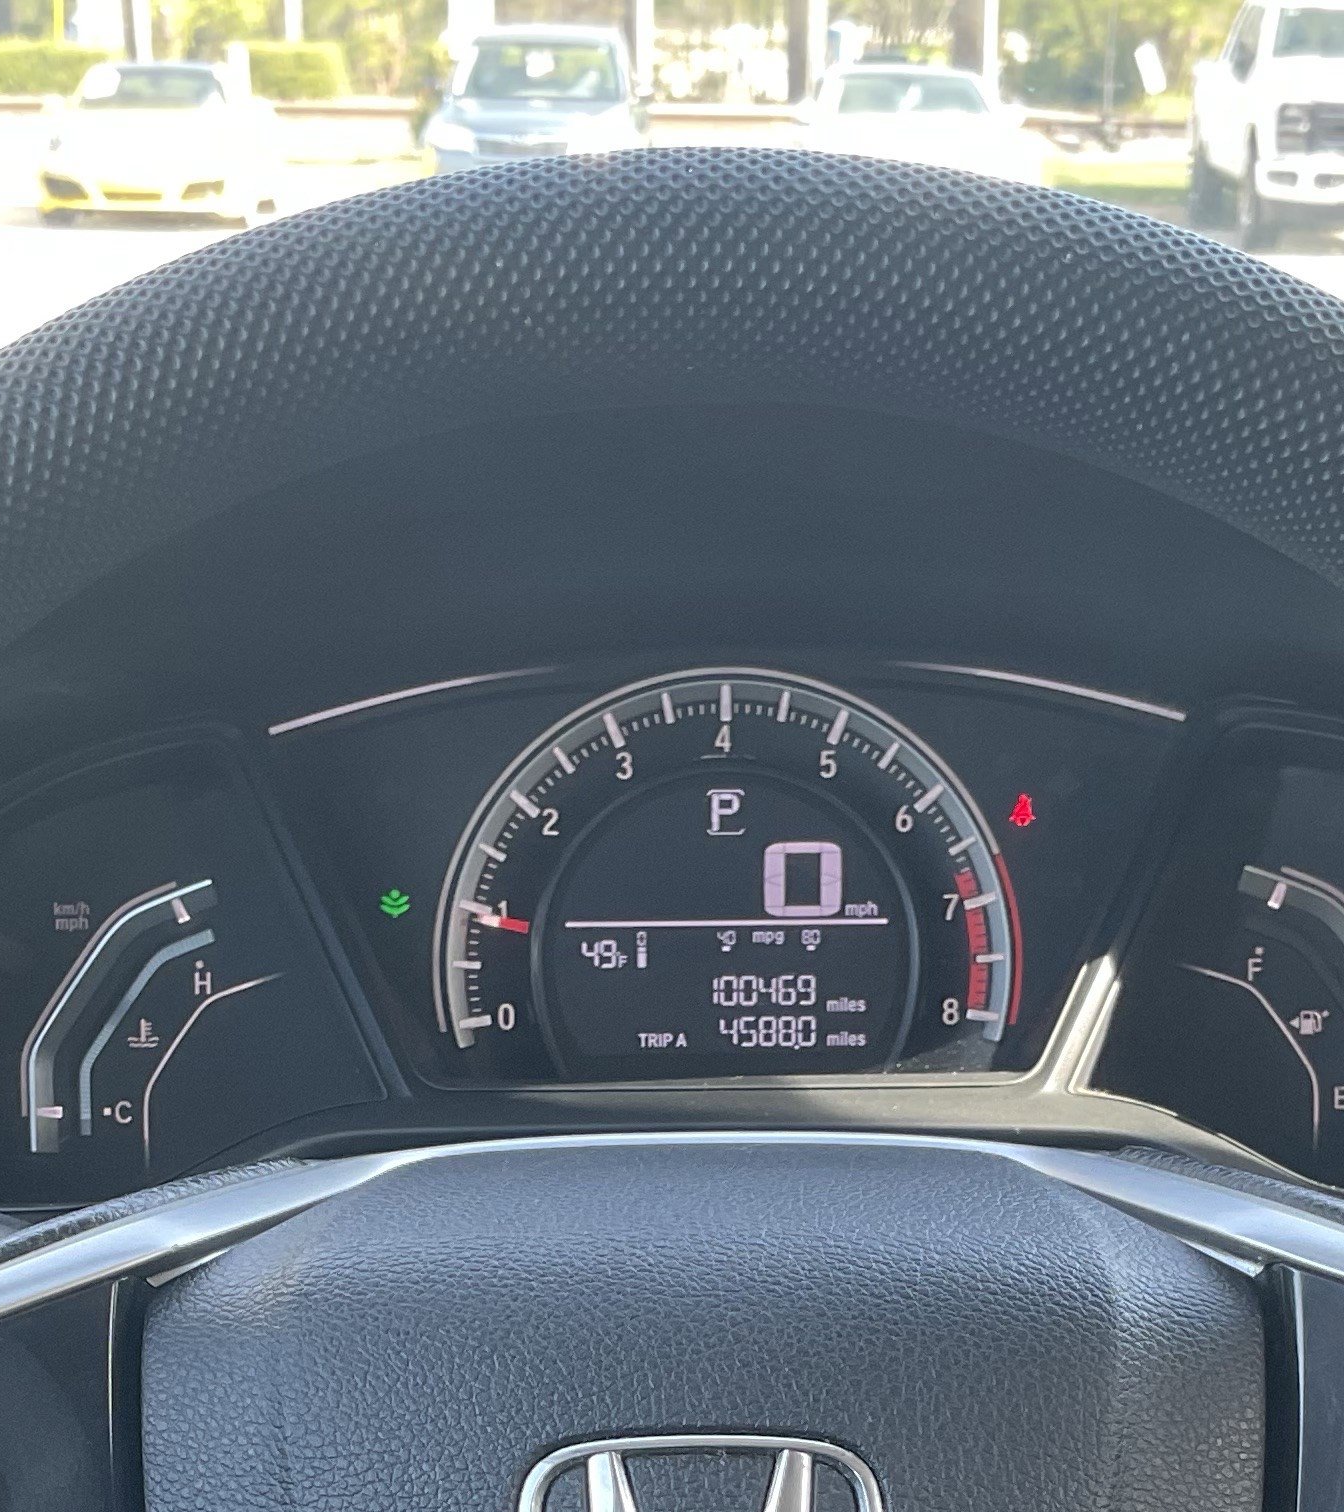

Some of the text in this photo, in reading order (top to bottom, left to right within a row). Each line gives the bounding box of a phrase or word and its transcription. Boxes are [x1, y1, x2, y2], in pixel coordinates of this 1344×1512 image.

[713, 724, 732, 753] 4
[615, 752, 634, 780] 3
[818, 750, 838, 779] 5
[541, 808, 559, 837] 2
[711, 794, 739, 832] P
[894, 804, 914, 833] 6
[763, 841, 879, 919] 0 mph
[53, 901, 90, 917] km/h
[942, 893, 959, 921] 7
[55, 916, 89, 932] mph
[716, 929, 821, 946] 40 mpg 80
[194, 971, 212, 995] H
[1248, 958, 1263, 981] F
[712, 974, 867, 1013] 100469 miles
[496, 1002, 516, 1032] 0
[940, 998, 960, 1026] 8
[637, 1033, 674, 1049] TRIP
[674, 1033, 688, 1048] A
[825, 1031, 867, 1048] miles
[115, 1100, 132, 1124] C
